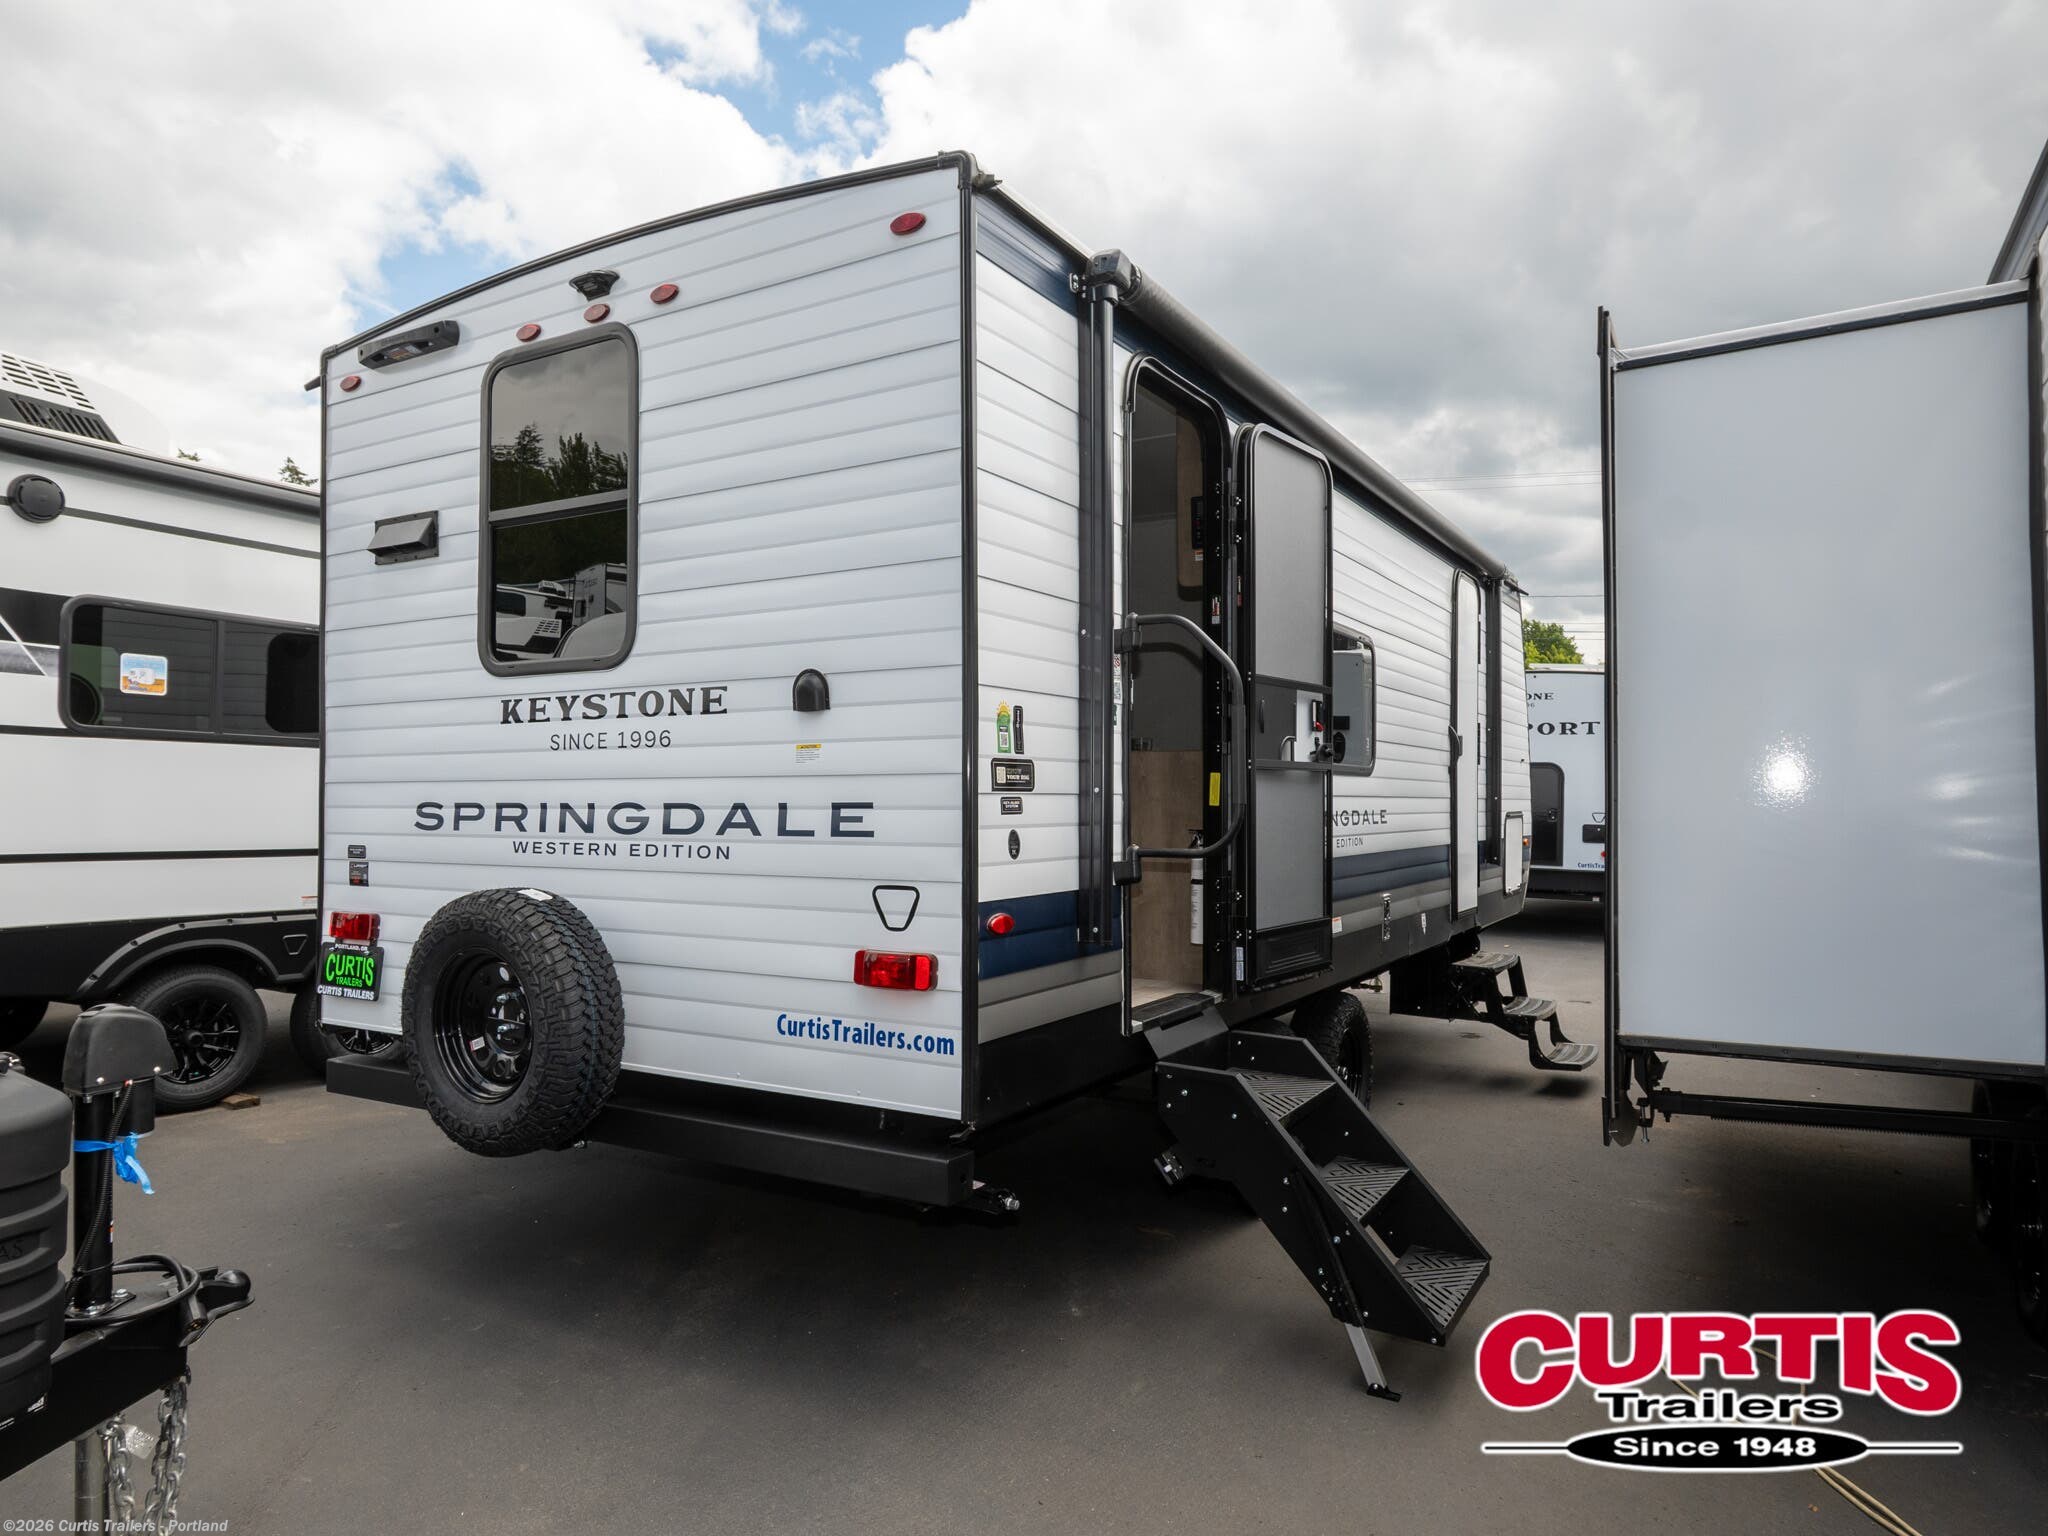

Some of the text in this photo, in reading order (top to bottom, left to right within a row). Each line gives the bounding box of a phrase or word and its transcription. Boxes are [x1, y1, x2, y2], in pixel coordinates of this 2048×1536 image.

[500, 685, 728, 724] KEYSTONE
[550, 730, 671, 751] SINCE 1996
[414, 801, 875, 839] SPRINGDALE
[512, 840, 731, 861] WESTERN EDITION
[1336, 837, 1364, 848] EDITION
[326, 953, 374, 987] CURTIS
[336, 976, 363, 987] TRAILERS
[317, 984, 375, 1001] CURTIS TRAILERS
[776, 1013, 955, 1056] CurtisTrailers.com
